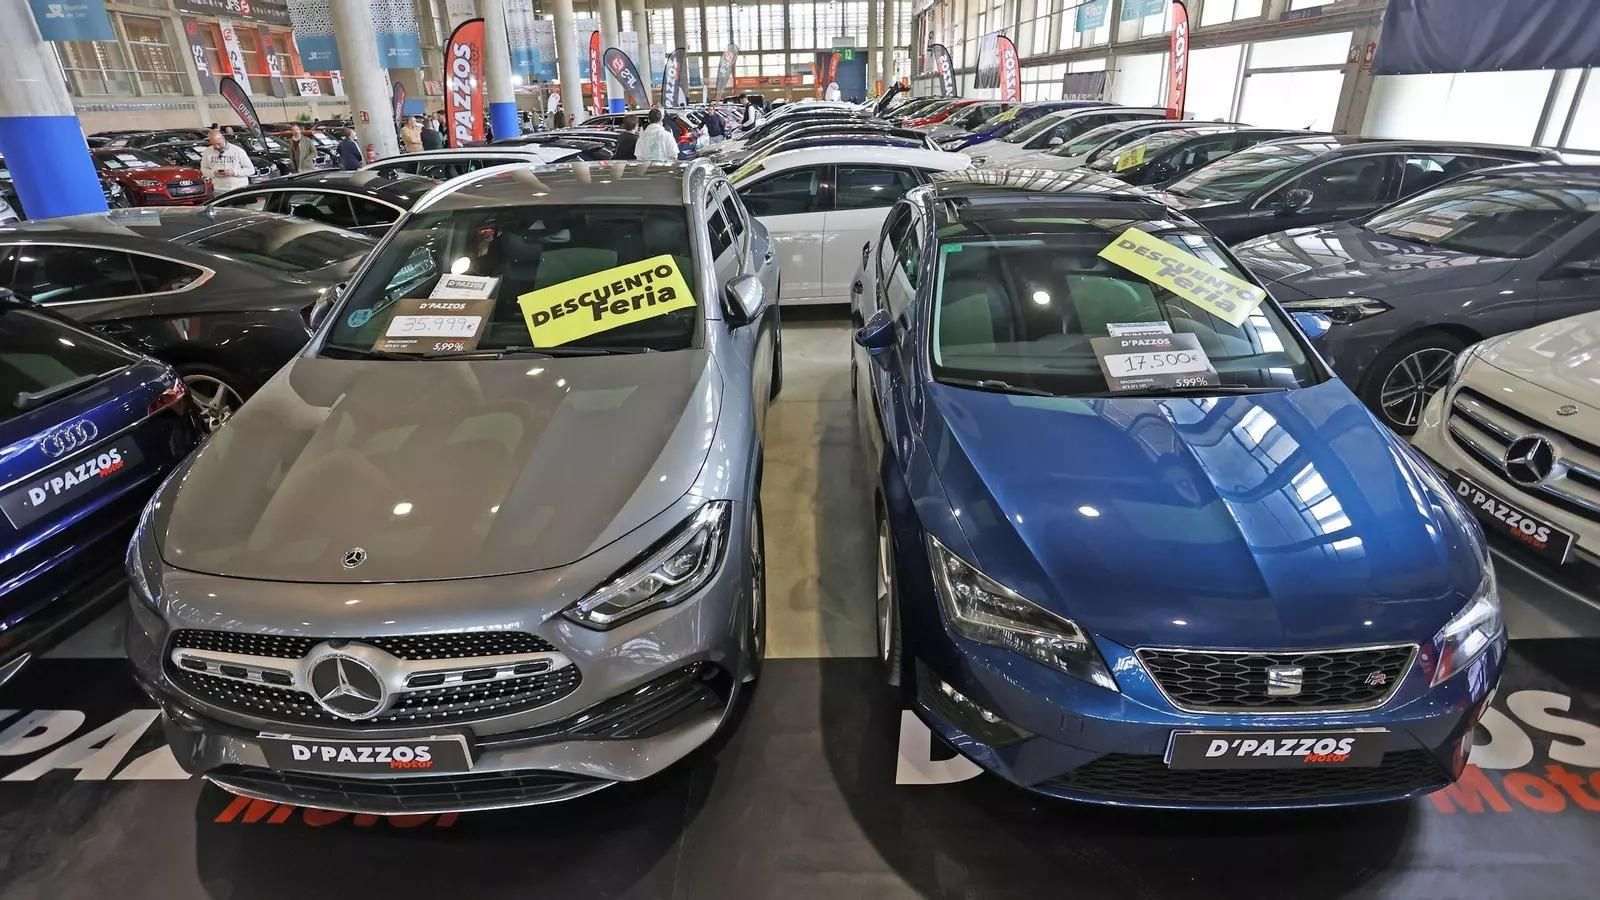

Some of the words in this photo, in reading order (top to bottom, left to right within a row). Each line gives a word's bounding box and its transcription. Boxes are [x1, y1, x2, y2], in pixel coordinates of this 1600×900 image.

[300, 82, 313, 92] JFS
[210, 155, 235, 164] AUSTIN
[1117, 238, 1256, 301] DESCUENTO
[531, 264, 673, 328] DESCUENTO
[1156, 265, 1237, 312] Feria
[419, 302, 467, 310] D'PAZZOS
[591, 286, 677, 321] Feria
[1121, 338, 1171, 347] D'PAZZOS
[28, 448, 122, 507] D'PAZZOS
[1456, 481, 1551, 543] D'PAZZOS
[291, 744, 433, 763] D'PAZZOS
[1205, 738, 1356, 758] D'PAZZOS
[1303, 752, 1352, 763] Motor
